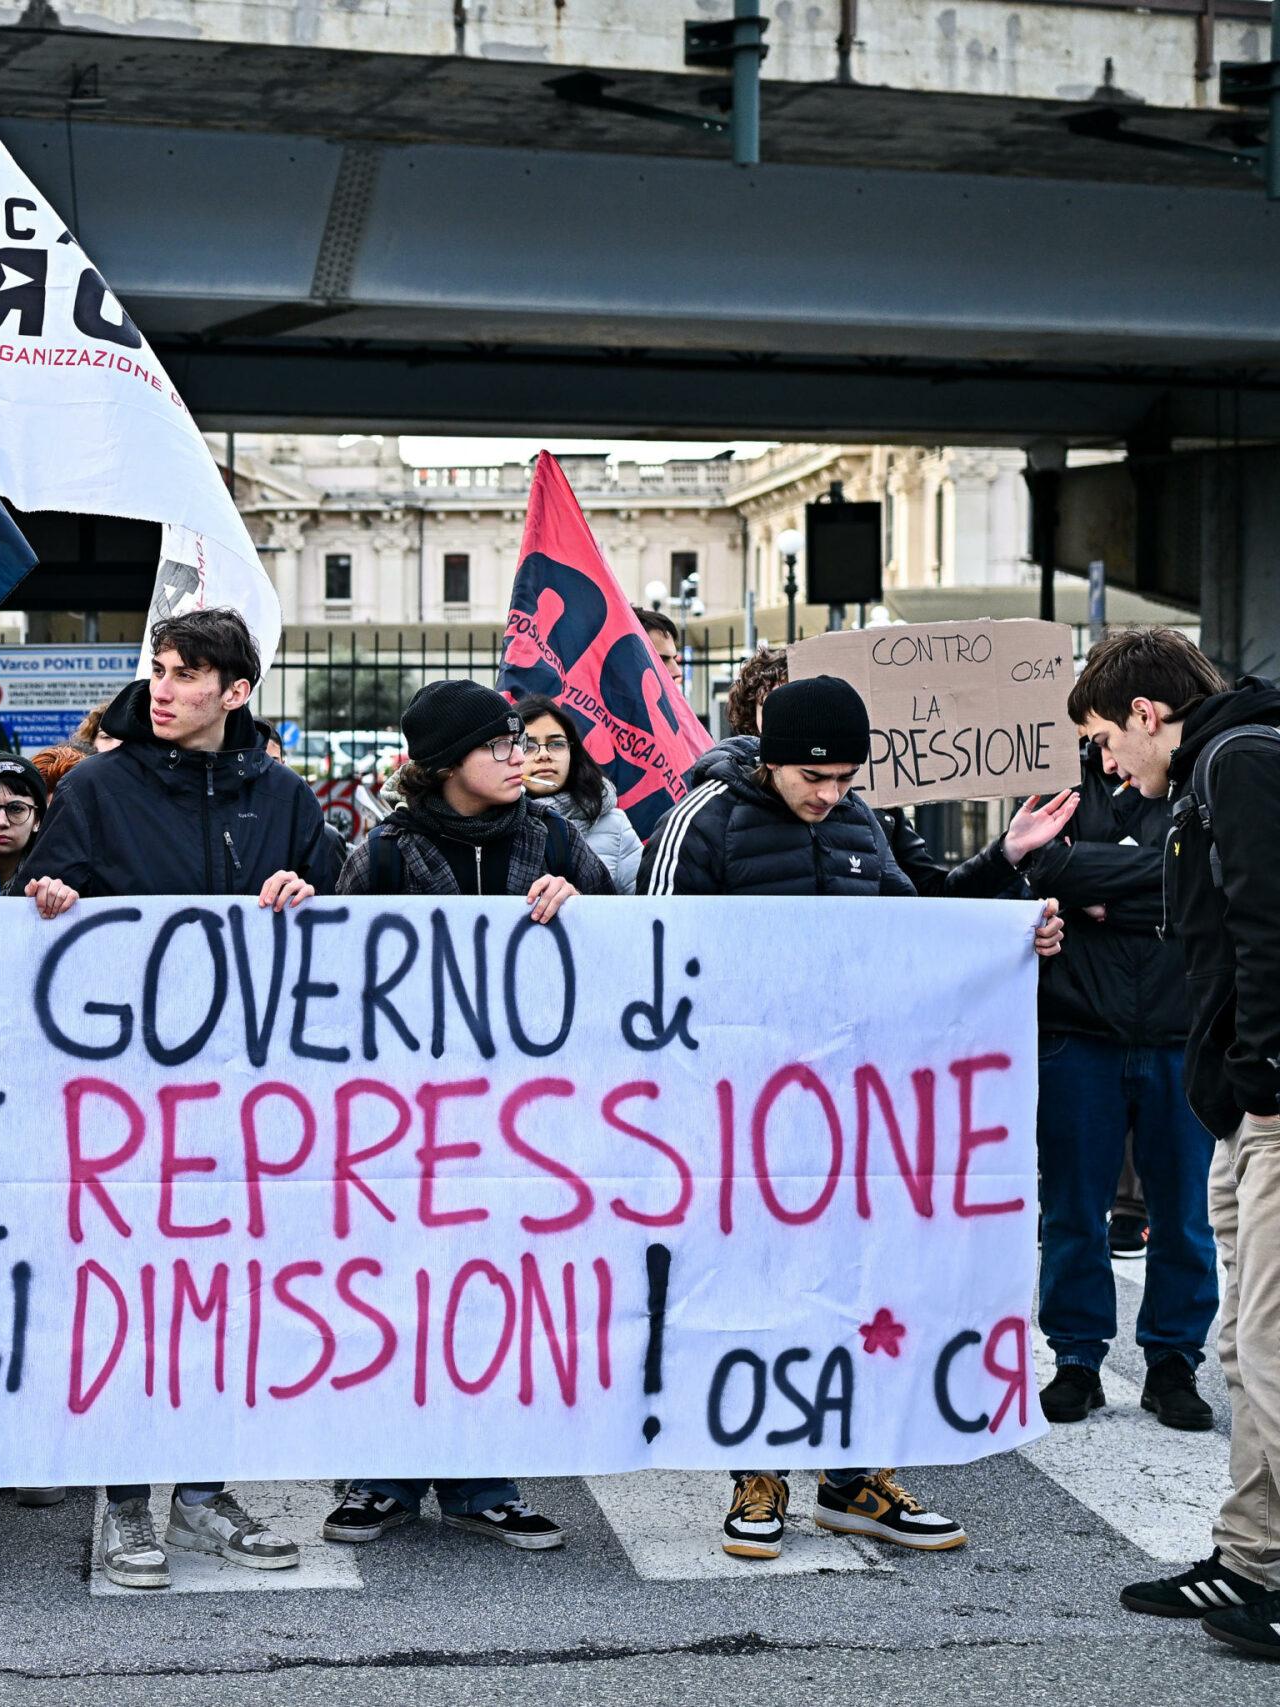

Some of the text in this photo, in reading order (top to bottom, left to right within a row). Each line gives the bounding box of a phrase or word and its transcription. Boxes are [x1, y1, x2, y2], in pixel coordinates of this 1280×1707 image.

[0, 656, 140, 670] Varco PONTE DEI M
[871, 634, 992, 666] CONTRO
[912, 695, 941, 722] LA
[851, 722, 1056, 791] PRESSIONE
[35, 904, 576, 1067] GOVERNO
[620, 918, 702, 1051] di
[64, 1051, 1026, 1243] REPRESSIONE
